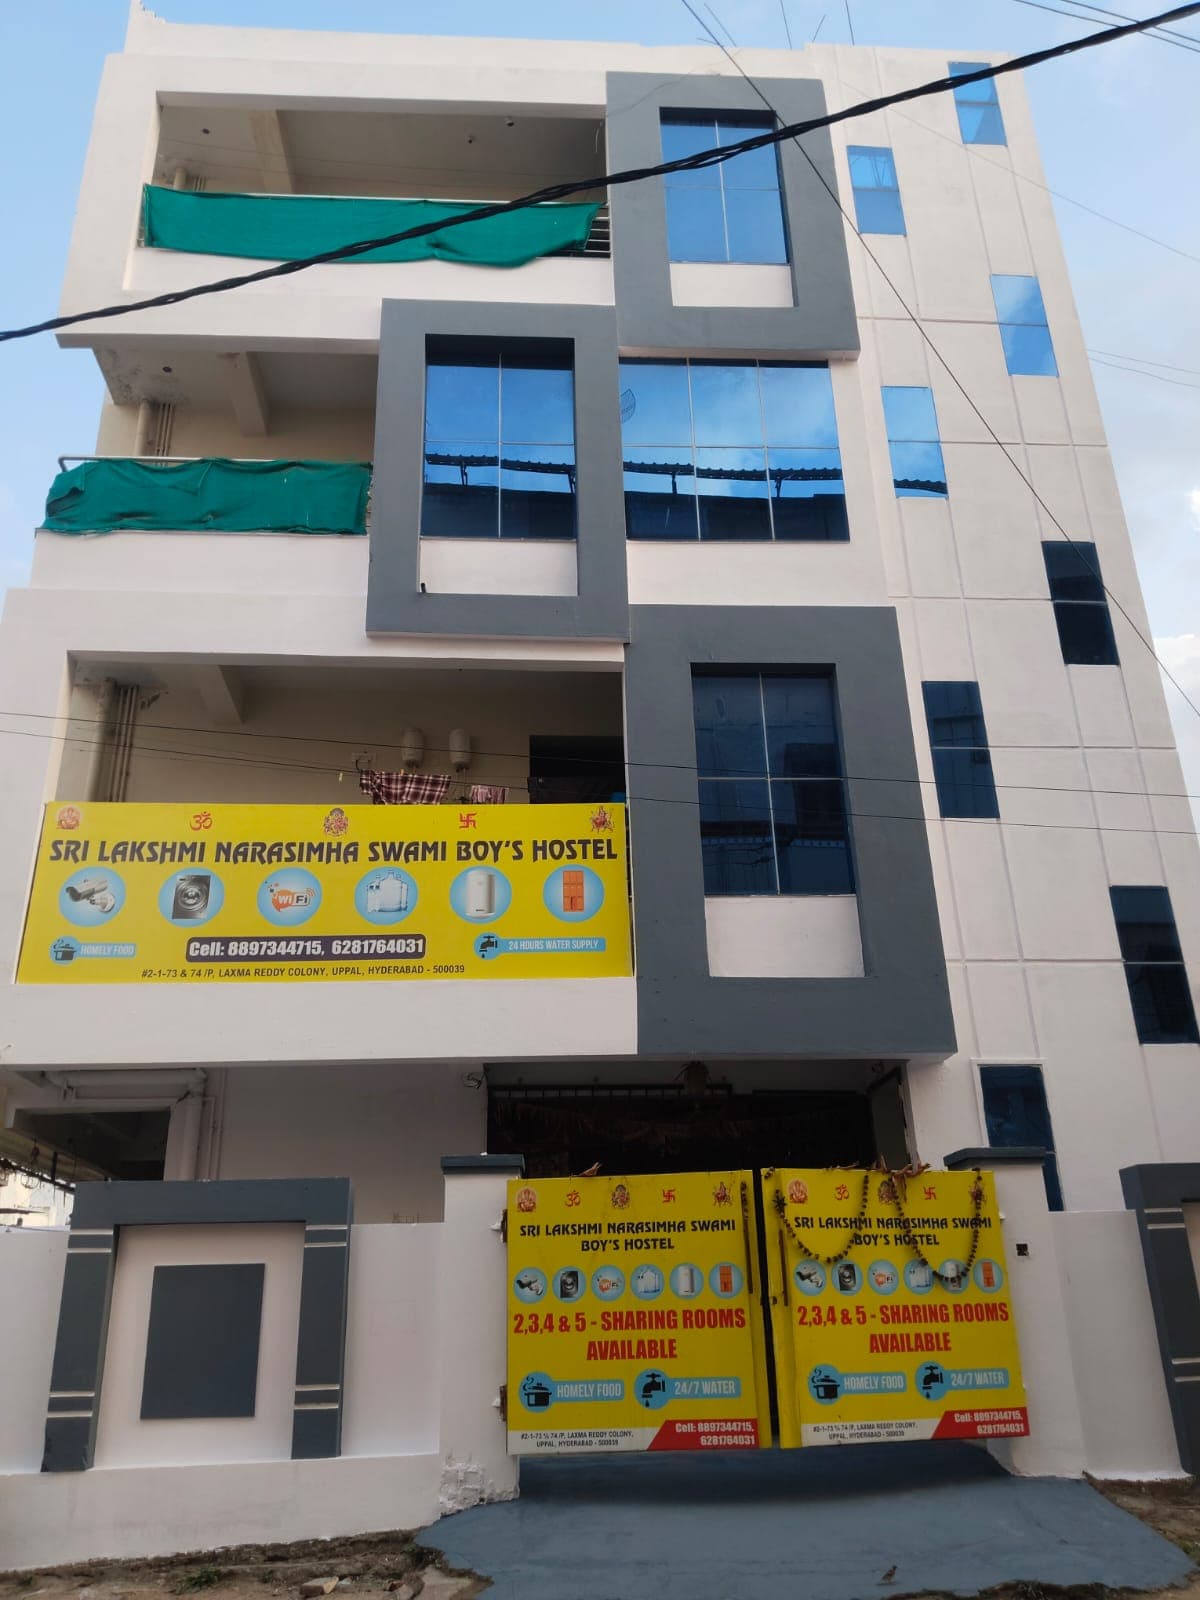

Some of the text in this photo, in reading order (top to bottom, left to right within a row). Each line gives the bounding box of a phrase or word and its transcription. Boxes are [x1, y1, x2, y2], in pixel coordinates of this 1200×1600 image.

[50, 839, 618, 864] SRI LAKSHMI NARASIMHA SWAMI BOY'S HOSTEL
[114, 944, 134, 954] FOOD
[189, 939, 423, 957] Cell: 8897344715, 6281764031
[508, 940, 599, 950] 24 HOURS WATER SUPPLY
[141, 969, 177, 978] #2-1-73
[180, 969, 187, 977] &
[191, 969, 201, 977] 74
[219, 968, 251, 977] LAXMA
[254, 968, 285, 977] REDDY
[288, 967, 329, 976] COLONY,
[332, 966, 365, 977] UPPAL,
[368, 965, 424, 975] HYDERABAD
[433, 964, 464, 974] 500039
[520, 1219, 736, 1237] SRI LAKSHMI NARASIMHA SWAMI
[794, 1217, 813, 1229] SRI
[819, 1217, 872, 1229] LAKSHMI
[581, 1238, 674, 1252] BOY'S HOSTEL
[855, 1234, 890, 1246] BOY'S
[513, 1313, 554, 1334] 2,3,4
[558, 1315, 571, 1332] &
[575, 1312, 587, 1331] 5
[601, 1310, 677, 1331] SHARING
[683, 1308, 746, 1329] ROOMS
[798, 1305, 836, 1327] 2,3,4
[841, 1308, 852, 1325] &
[856, 1306, 867, 1325] 5
[881, 1304, 949, 1325] SHARING
[954, 1302, 1009, 1323] ROOMS
[586, 1339, 677, 1360] AVAILABLE
[869, 1332, 952, 1354] AVAILABLE
[844, 1375, 904, 1390] HOMELY FOOD
[952, 1371, 1004, 1386] 24/7 WATER
[557, 1382, 622, 1398] HOMELY FOOD
[674, 1380, 735, 1395] 24/7 WATER
